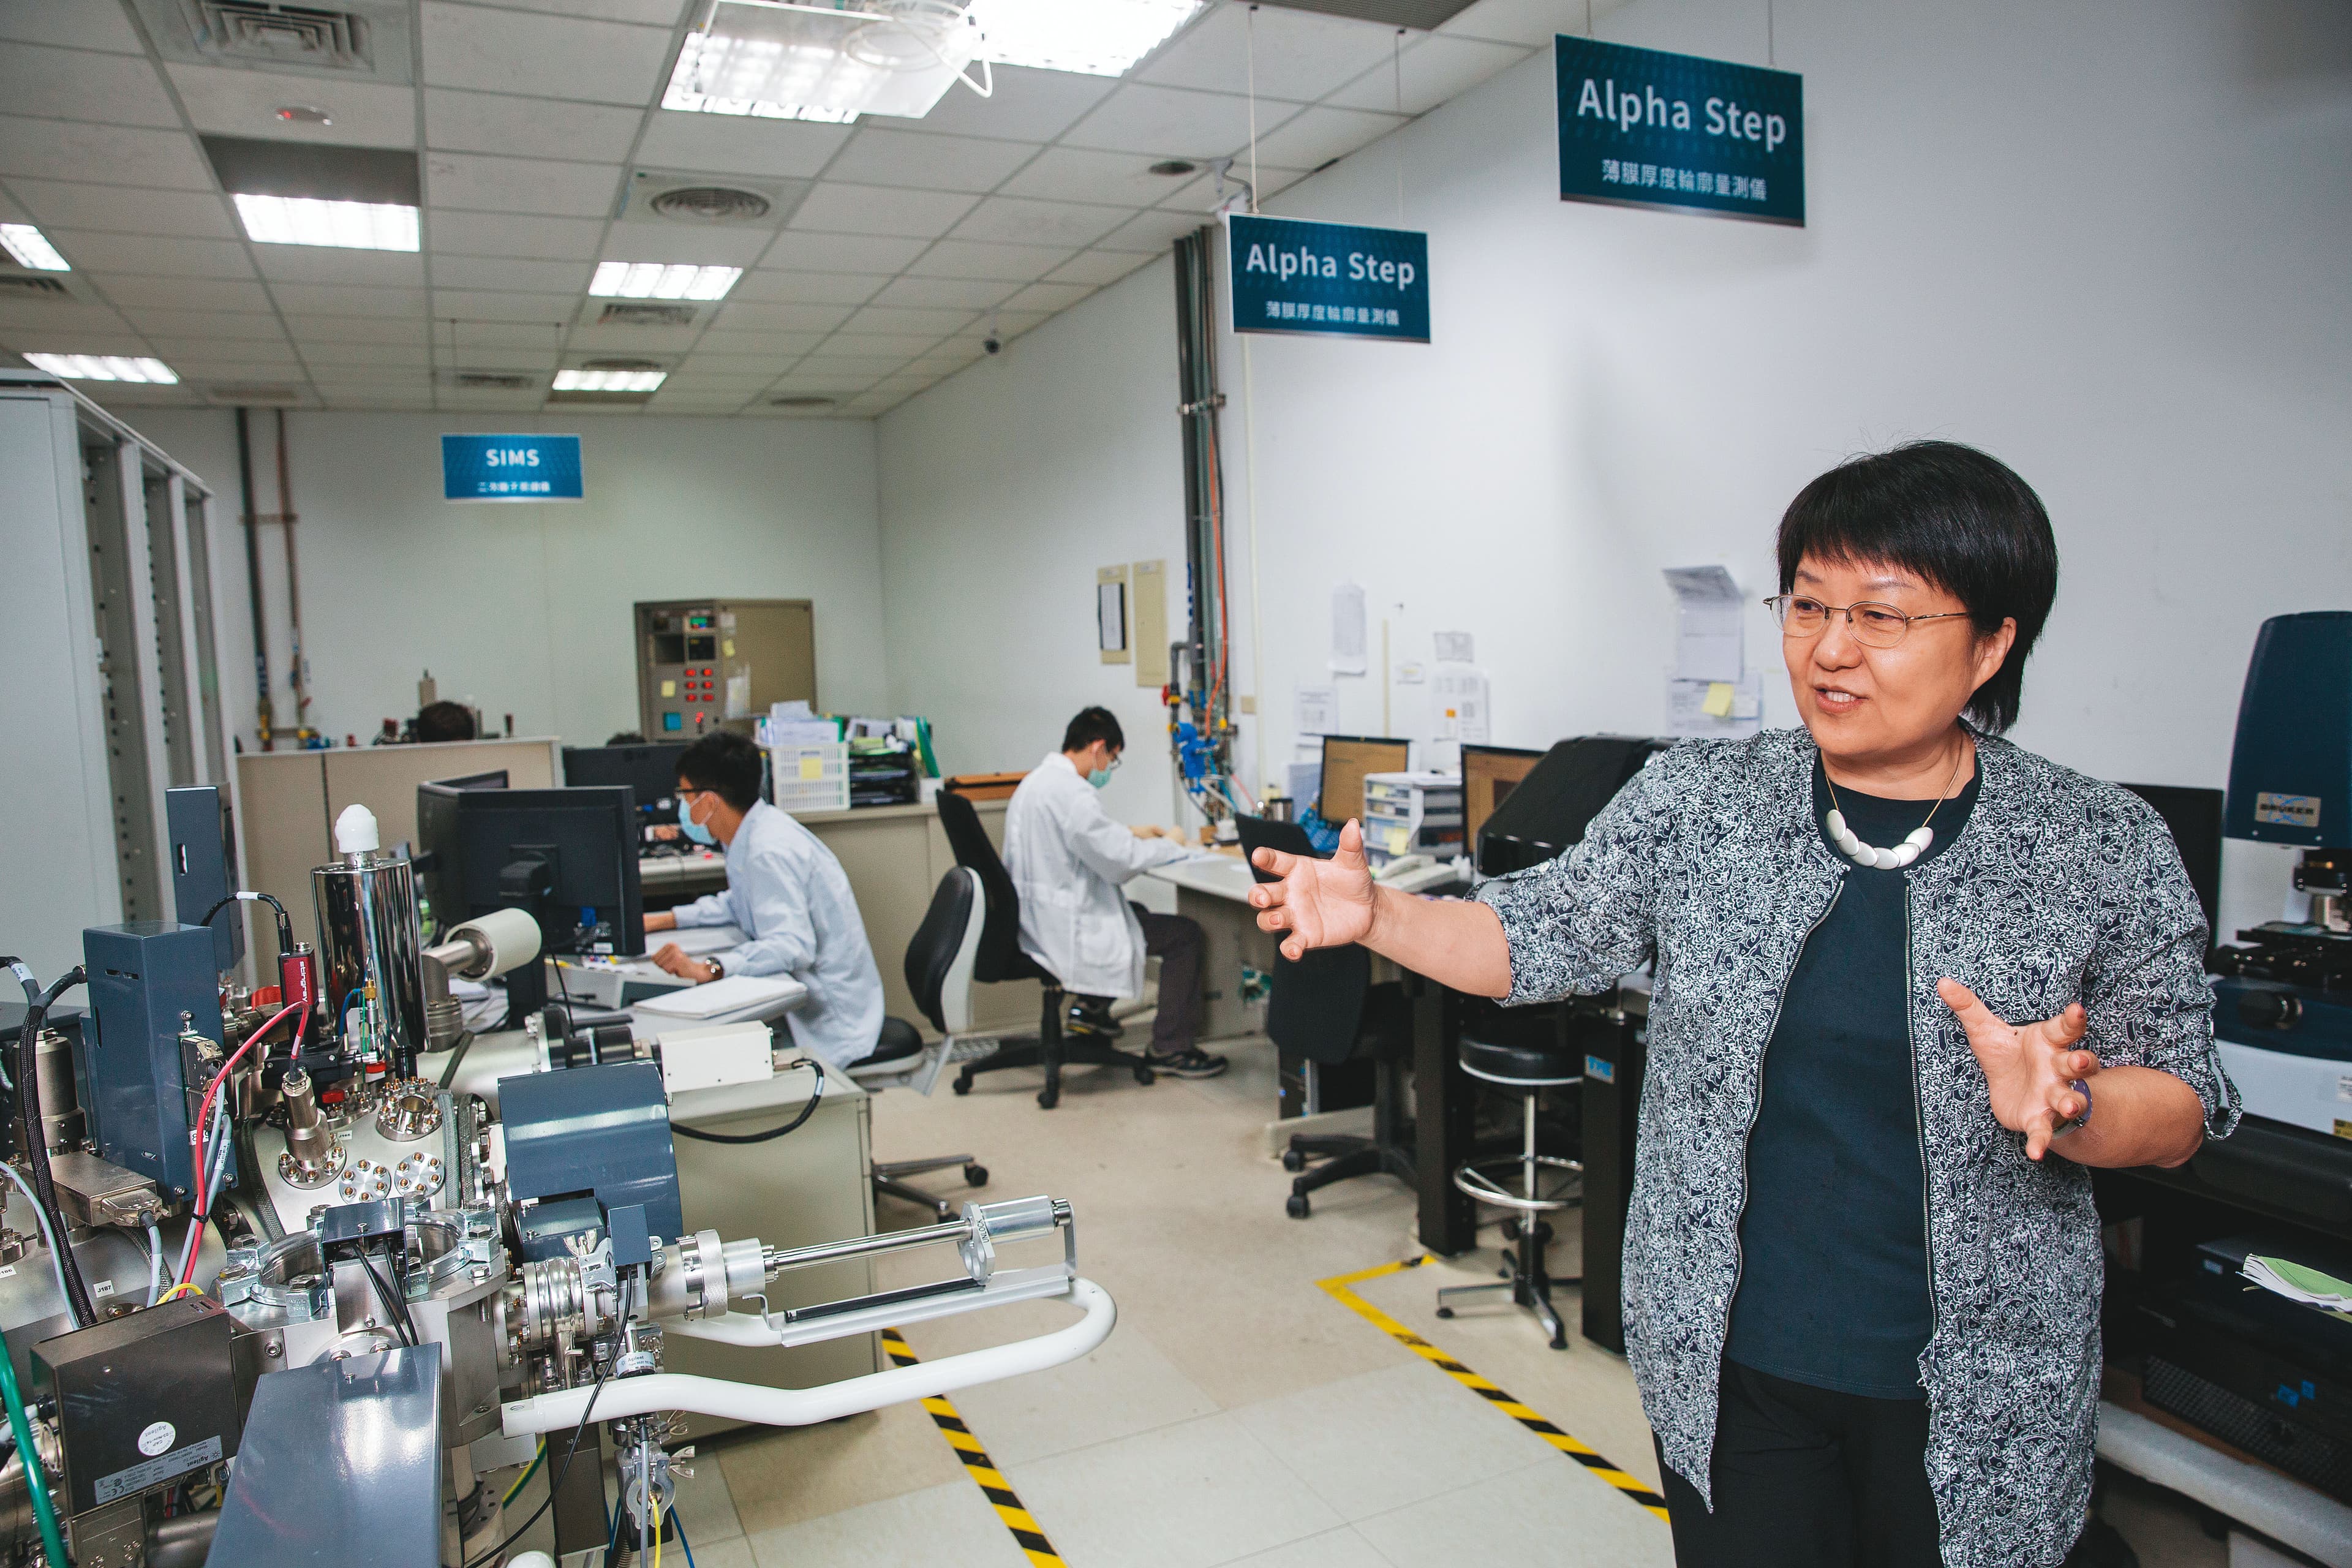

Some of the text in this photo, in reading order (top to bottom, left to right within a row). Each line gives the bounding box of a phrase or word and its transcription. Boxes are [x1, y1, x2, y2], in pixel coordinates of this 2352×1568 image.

[1577, 78, 1787, 153] Alpha Step
[1245, 243, 1415, 292] Alpha Step
[485, 448, 540, 467] SIMS
[299, 960, 308, 1002] stingray
[976, 1219, 990, 1243] UNLOCK
[97, 1284, 111, 1293] J187
[145, 1425, 167, 1437] Agilent
[187, 1455, 209, 1467] Agilent
